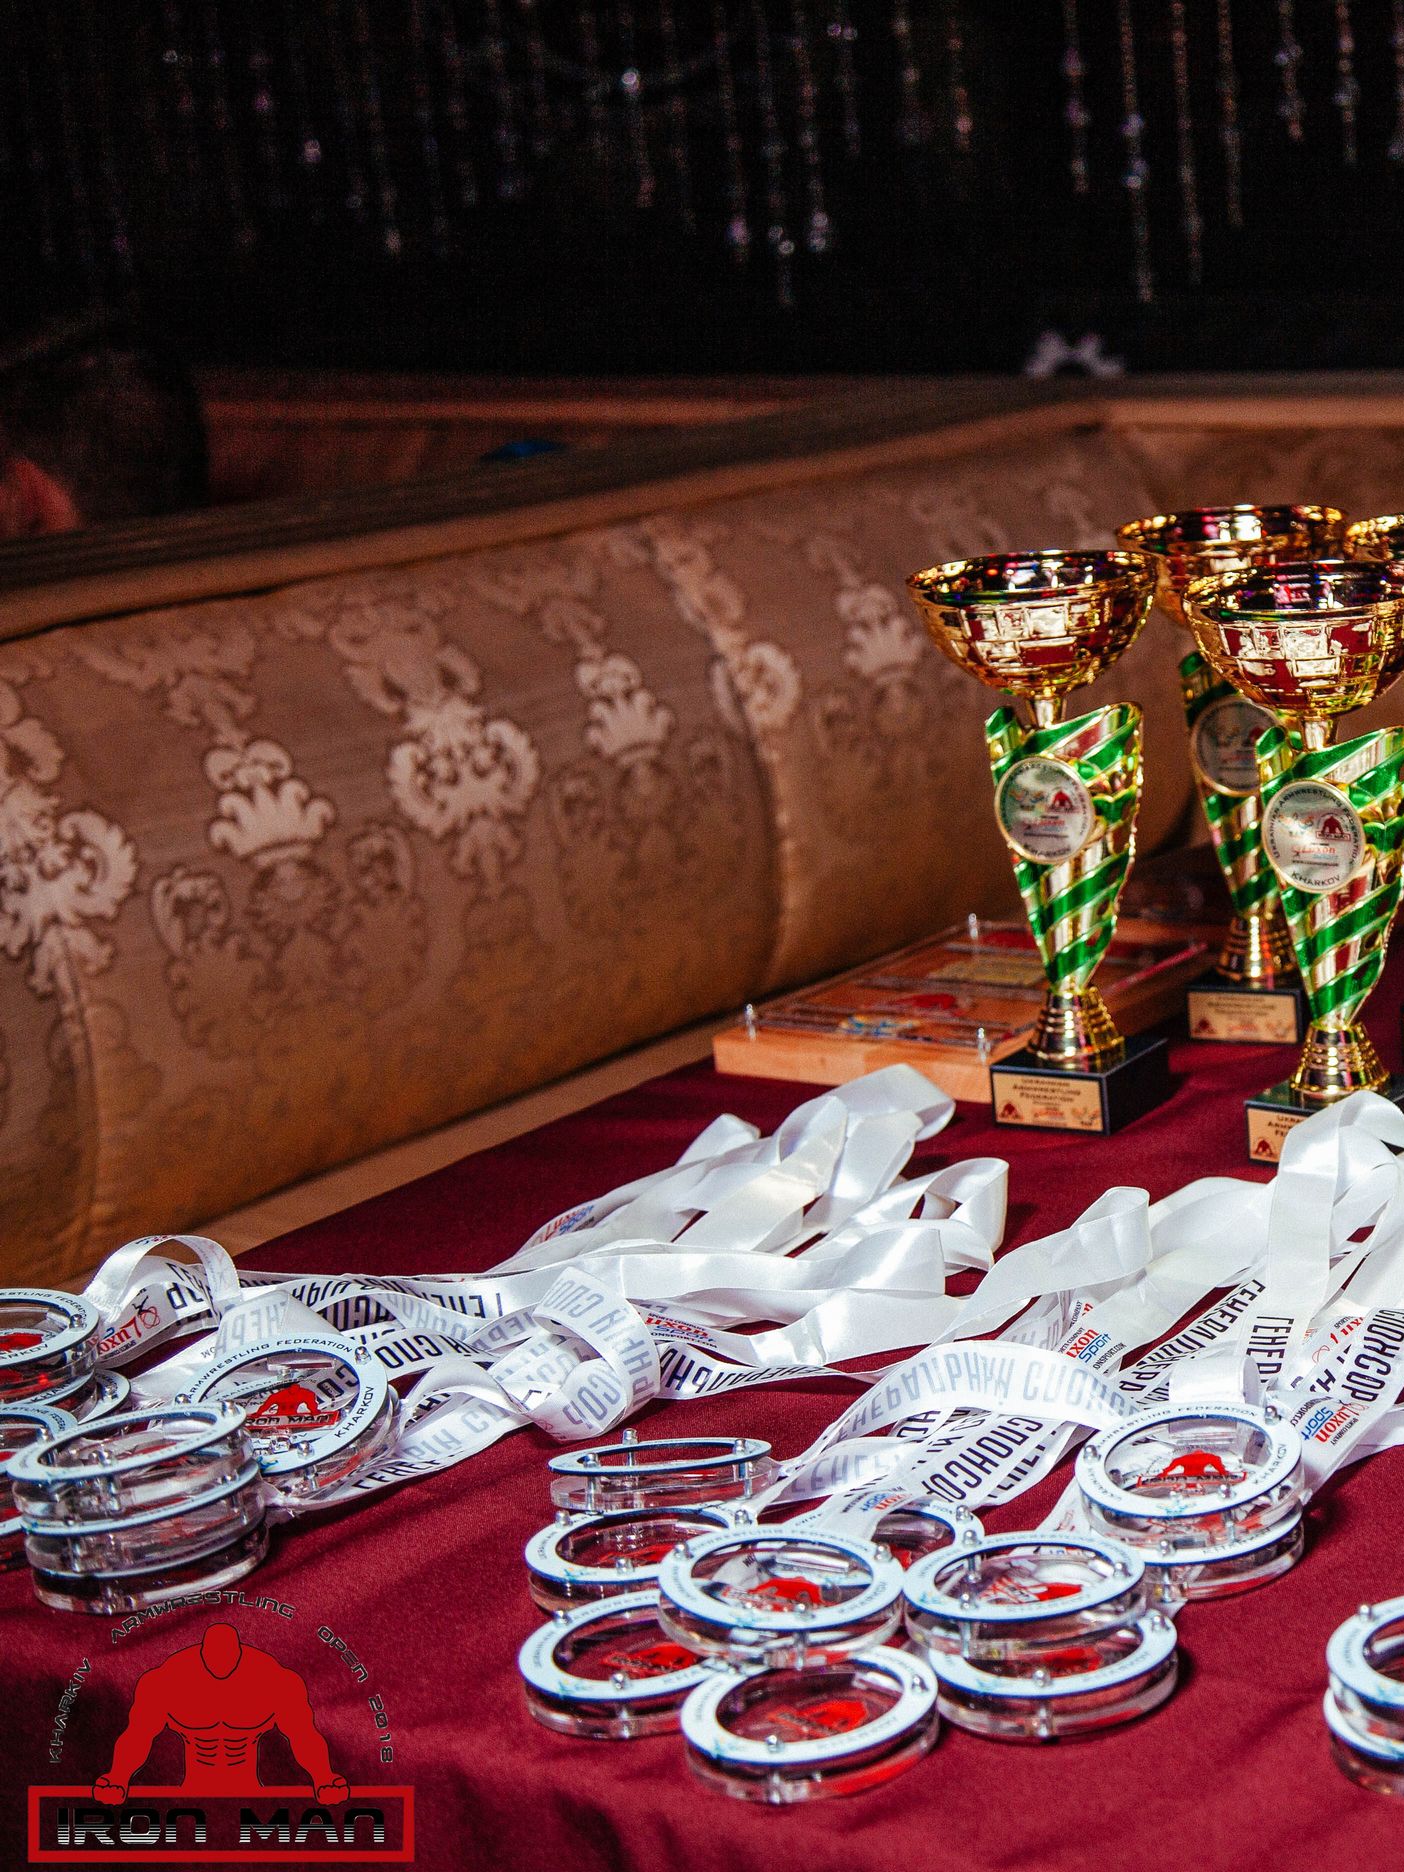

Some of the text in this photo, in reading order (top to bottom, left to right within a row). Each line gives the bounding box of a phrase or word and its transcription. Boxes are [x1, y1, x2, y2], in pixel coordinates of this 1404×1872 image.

[645, 1316, 710, 1338] uxon
[650, 1331, 718, 1349] ONSPORT.COM
[1065, 1328, 1100, 1359] xon
[1078, 1333, 1112, 1364] Sport
[1092, 1342, 1127, 1371] ONSPORT.COM
[188, 1338, 354, 1400] ARMWRESTLING FEDERATION
[333, 1385, 376, 1440] KHARKOV
[1177, 1405, 1258, 1418] FEDERATION
[1300, 1406, 1335, 1441] Sport
[1314, 1404, 1360, 1443] Luxon
[1254, 1442, 1287, 1486] KHARKOV
